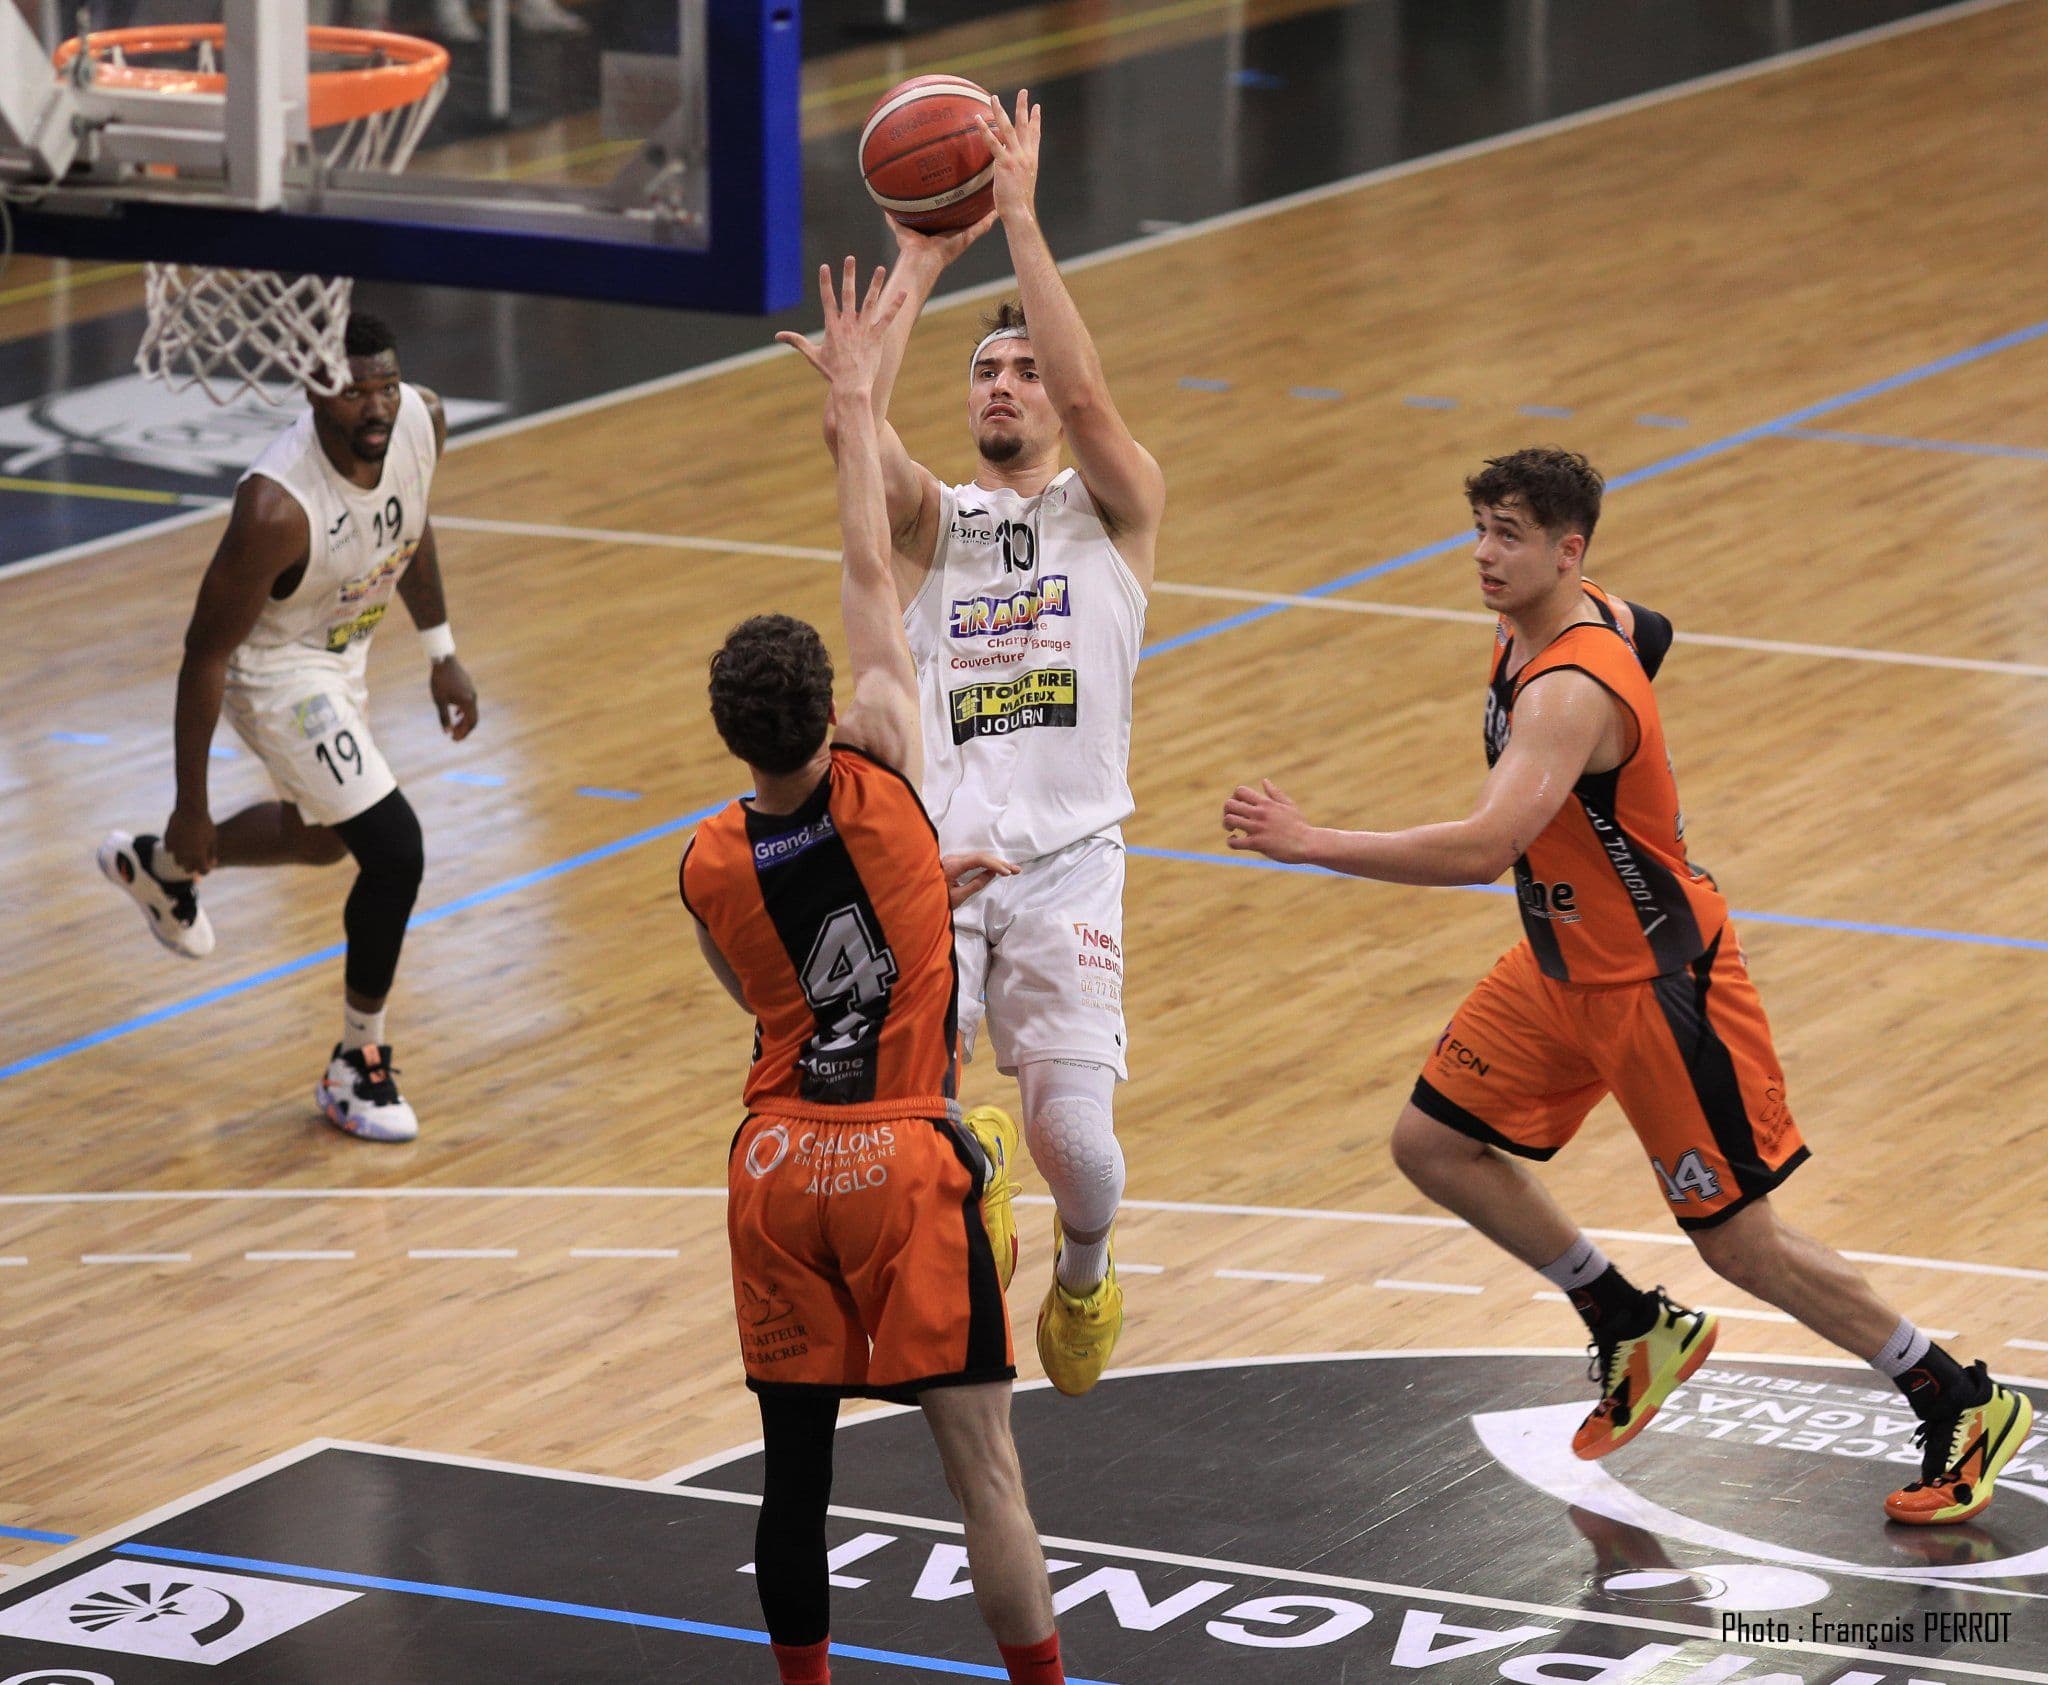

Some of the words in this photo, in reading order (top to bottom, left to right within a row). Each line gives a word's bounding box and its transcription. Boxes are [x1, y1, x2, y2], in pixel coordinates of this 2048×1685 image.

[373, 496, 403, 548] 19
[995, 519, 1035, 574] 10
[950, 652, 1025, 670] Couverture
[982, 674, 1033, 700] TOUT
[316, 729, 363, 785] 19
[754, 826, 810, 860] Grand
[800, 902, 900, 1010] 4
[1446, 1039, 1490, 1076] FCN
[793, 1152, 811, 1167] EN
[1653, 1148, 1724, 1203] 14
